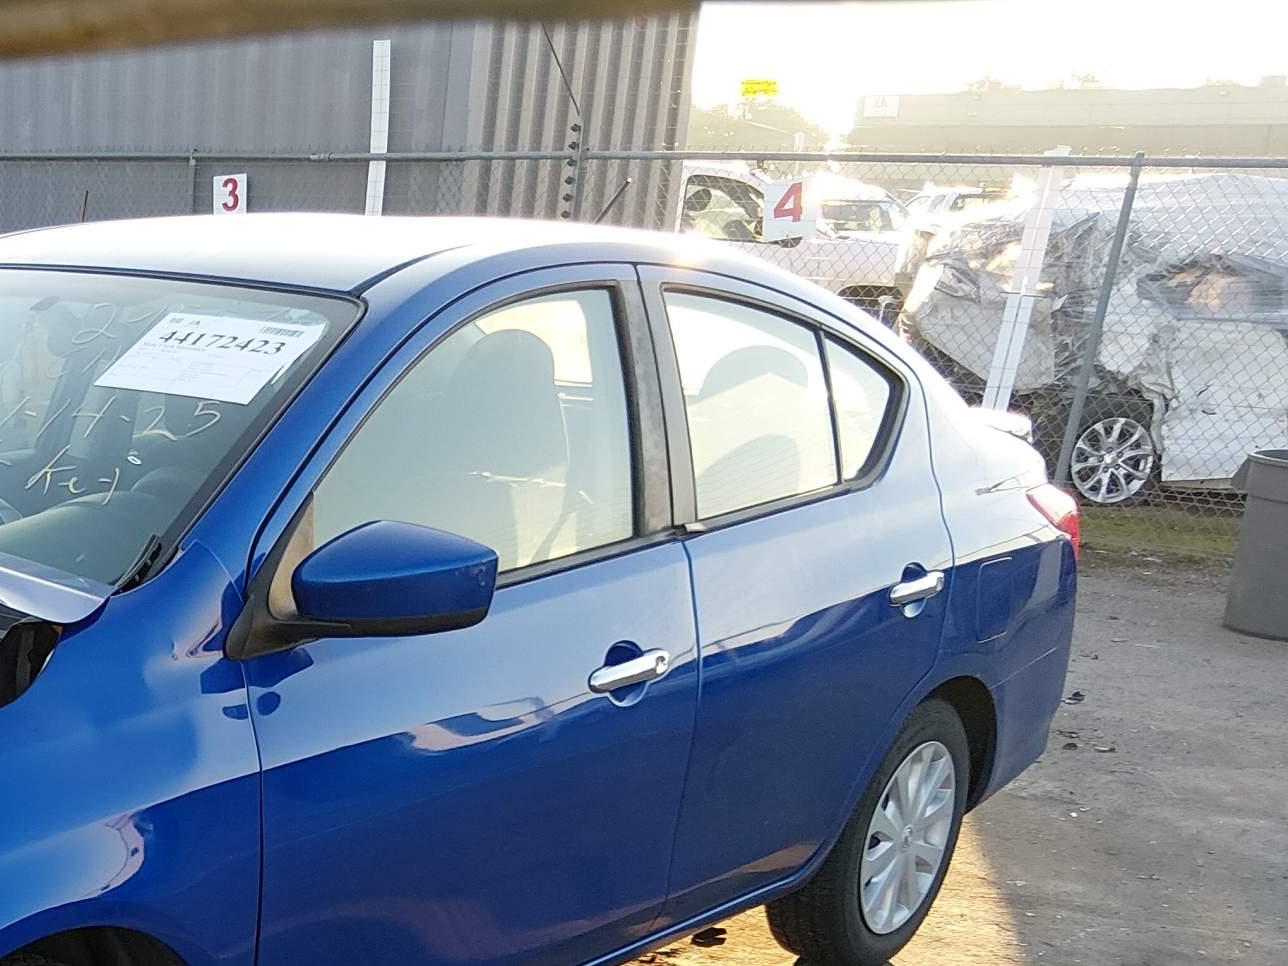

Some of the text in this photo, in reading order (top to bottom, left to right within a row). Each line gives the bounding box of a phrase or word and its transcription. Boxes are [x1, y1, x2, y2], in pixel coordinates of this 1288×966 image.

[222, 177, 239, 212] 3
[773, 182, 802, 223] 4
[159, 330, 286, 356] 44172423
